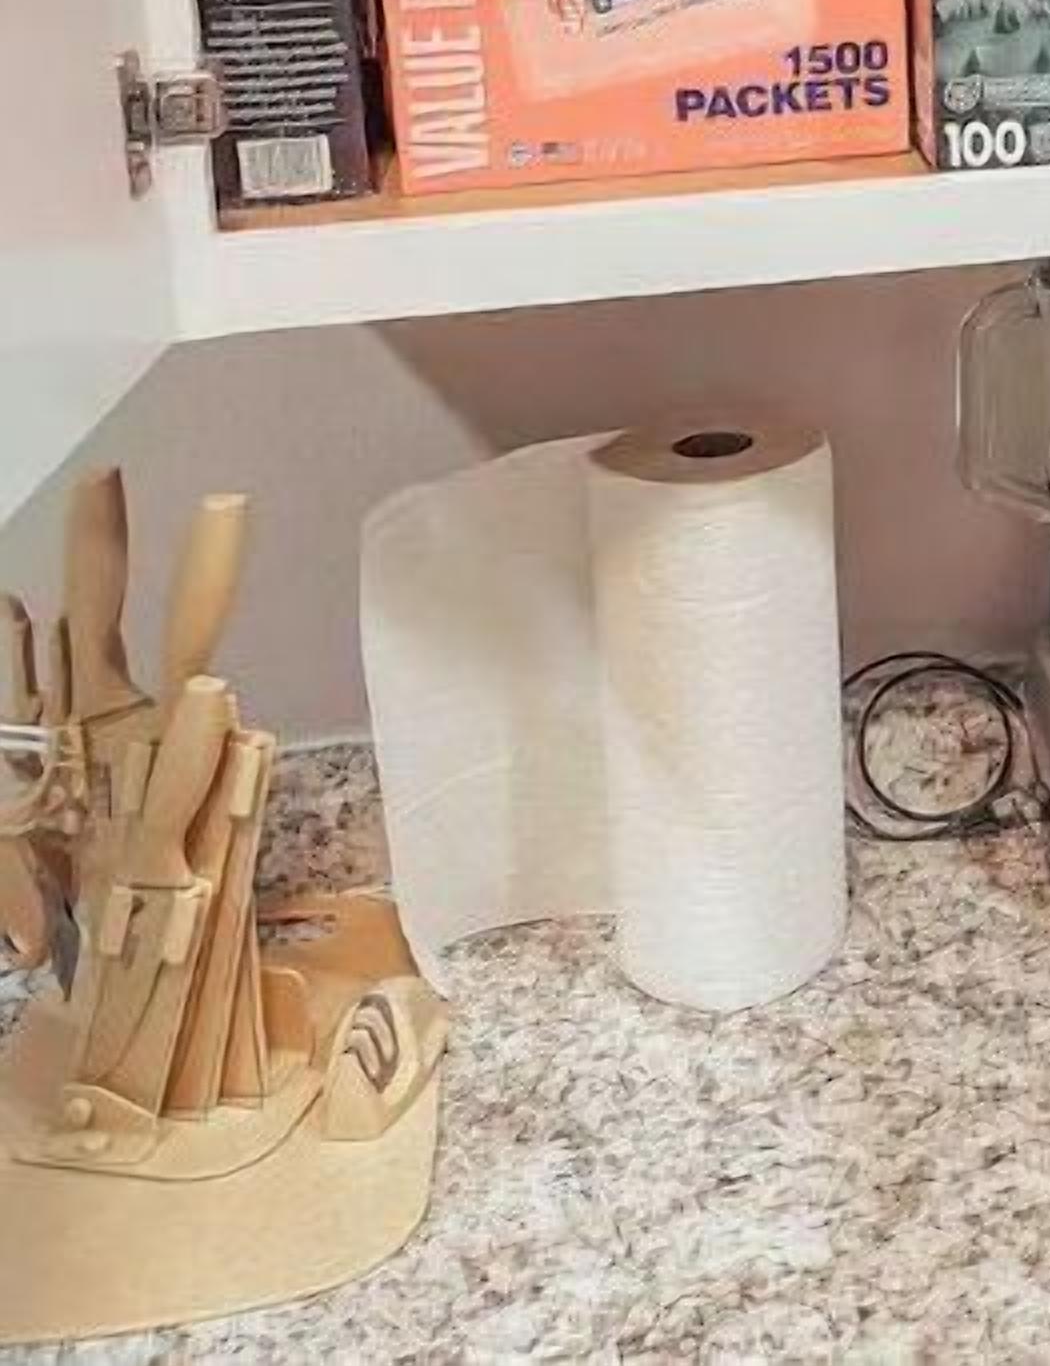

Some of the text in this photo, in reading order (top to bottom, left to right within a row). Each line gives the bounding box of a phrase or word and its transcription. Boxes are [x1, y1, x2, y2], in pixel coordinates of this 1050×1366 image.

[787, 40, 889, 76] 1500
[402, 24, 490, 180] VALUE
[675, 75, 890, 121] PACKETS
[944, 120, 1026, 167] 100
